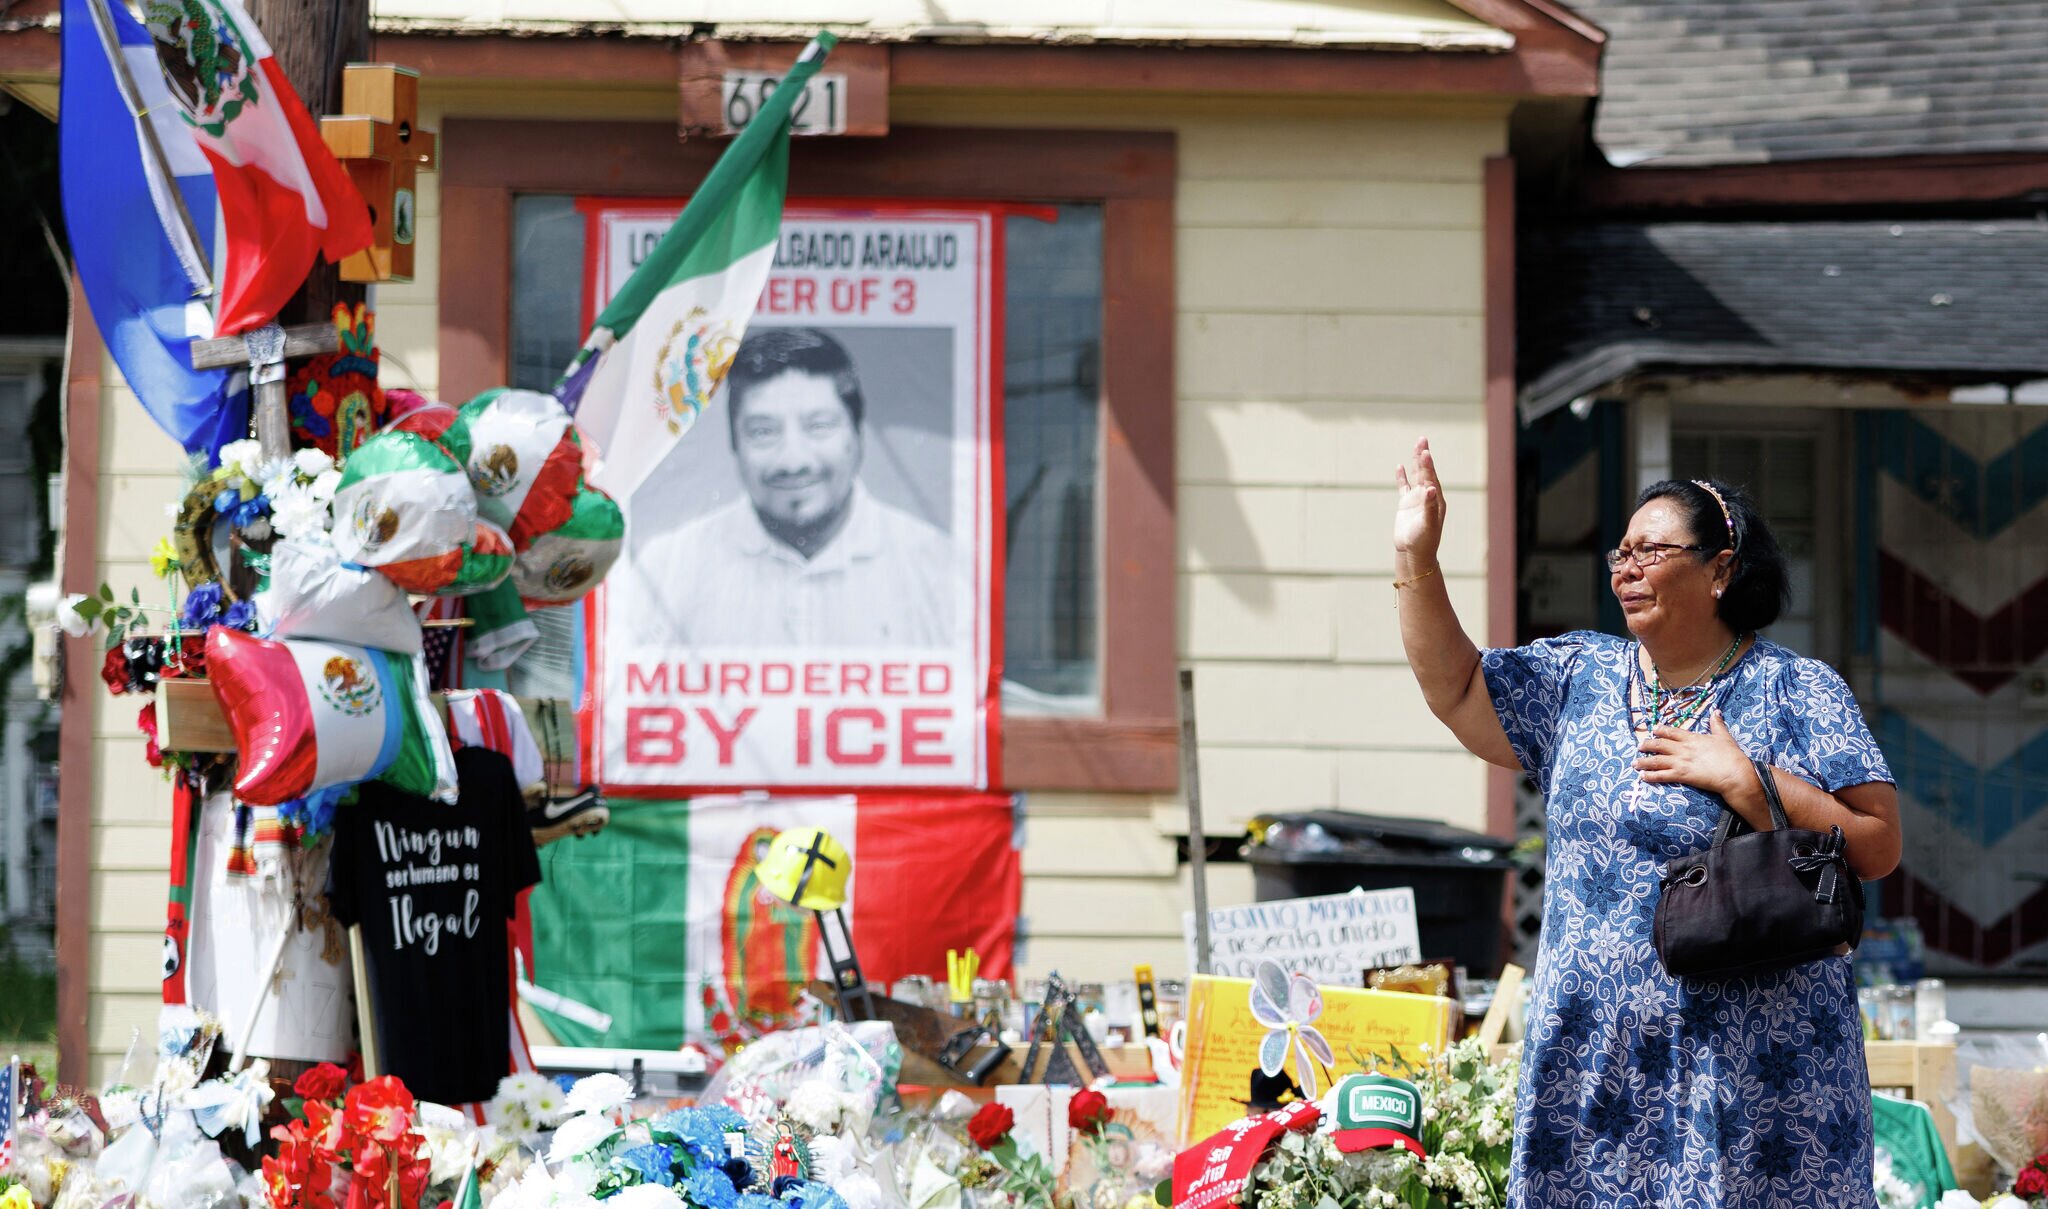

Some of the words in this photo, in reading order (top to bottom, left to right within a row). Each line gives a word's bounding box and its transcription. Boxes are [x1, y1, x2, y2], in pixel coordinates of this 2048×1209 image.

[861, 231, 957, 268] ARAUJO
[830, 277, 881, 315] OF
[893, 277, 917, 315] 3
[626, 661, 952, 696] MURDERED
[625, 706, 758, 766] BY
[796, 707, 955, 766] ICE
[374, 820, 480, 865] Ningun
[463, 863, 480, 881] es
[1328, 919, 1398, 948] unido
[1361, 1095, 1407, 1115] MEXICO
